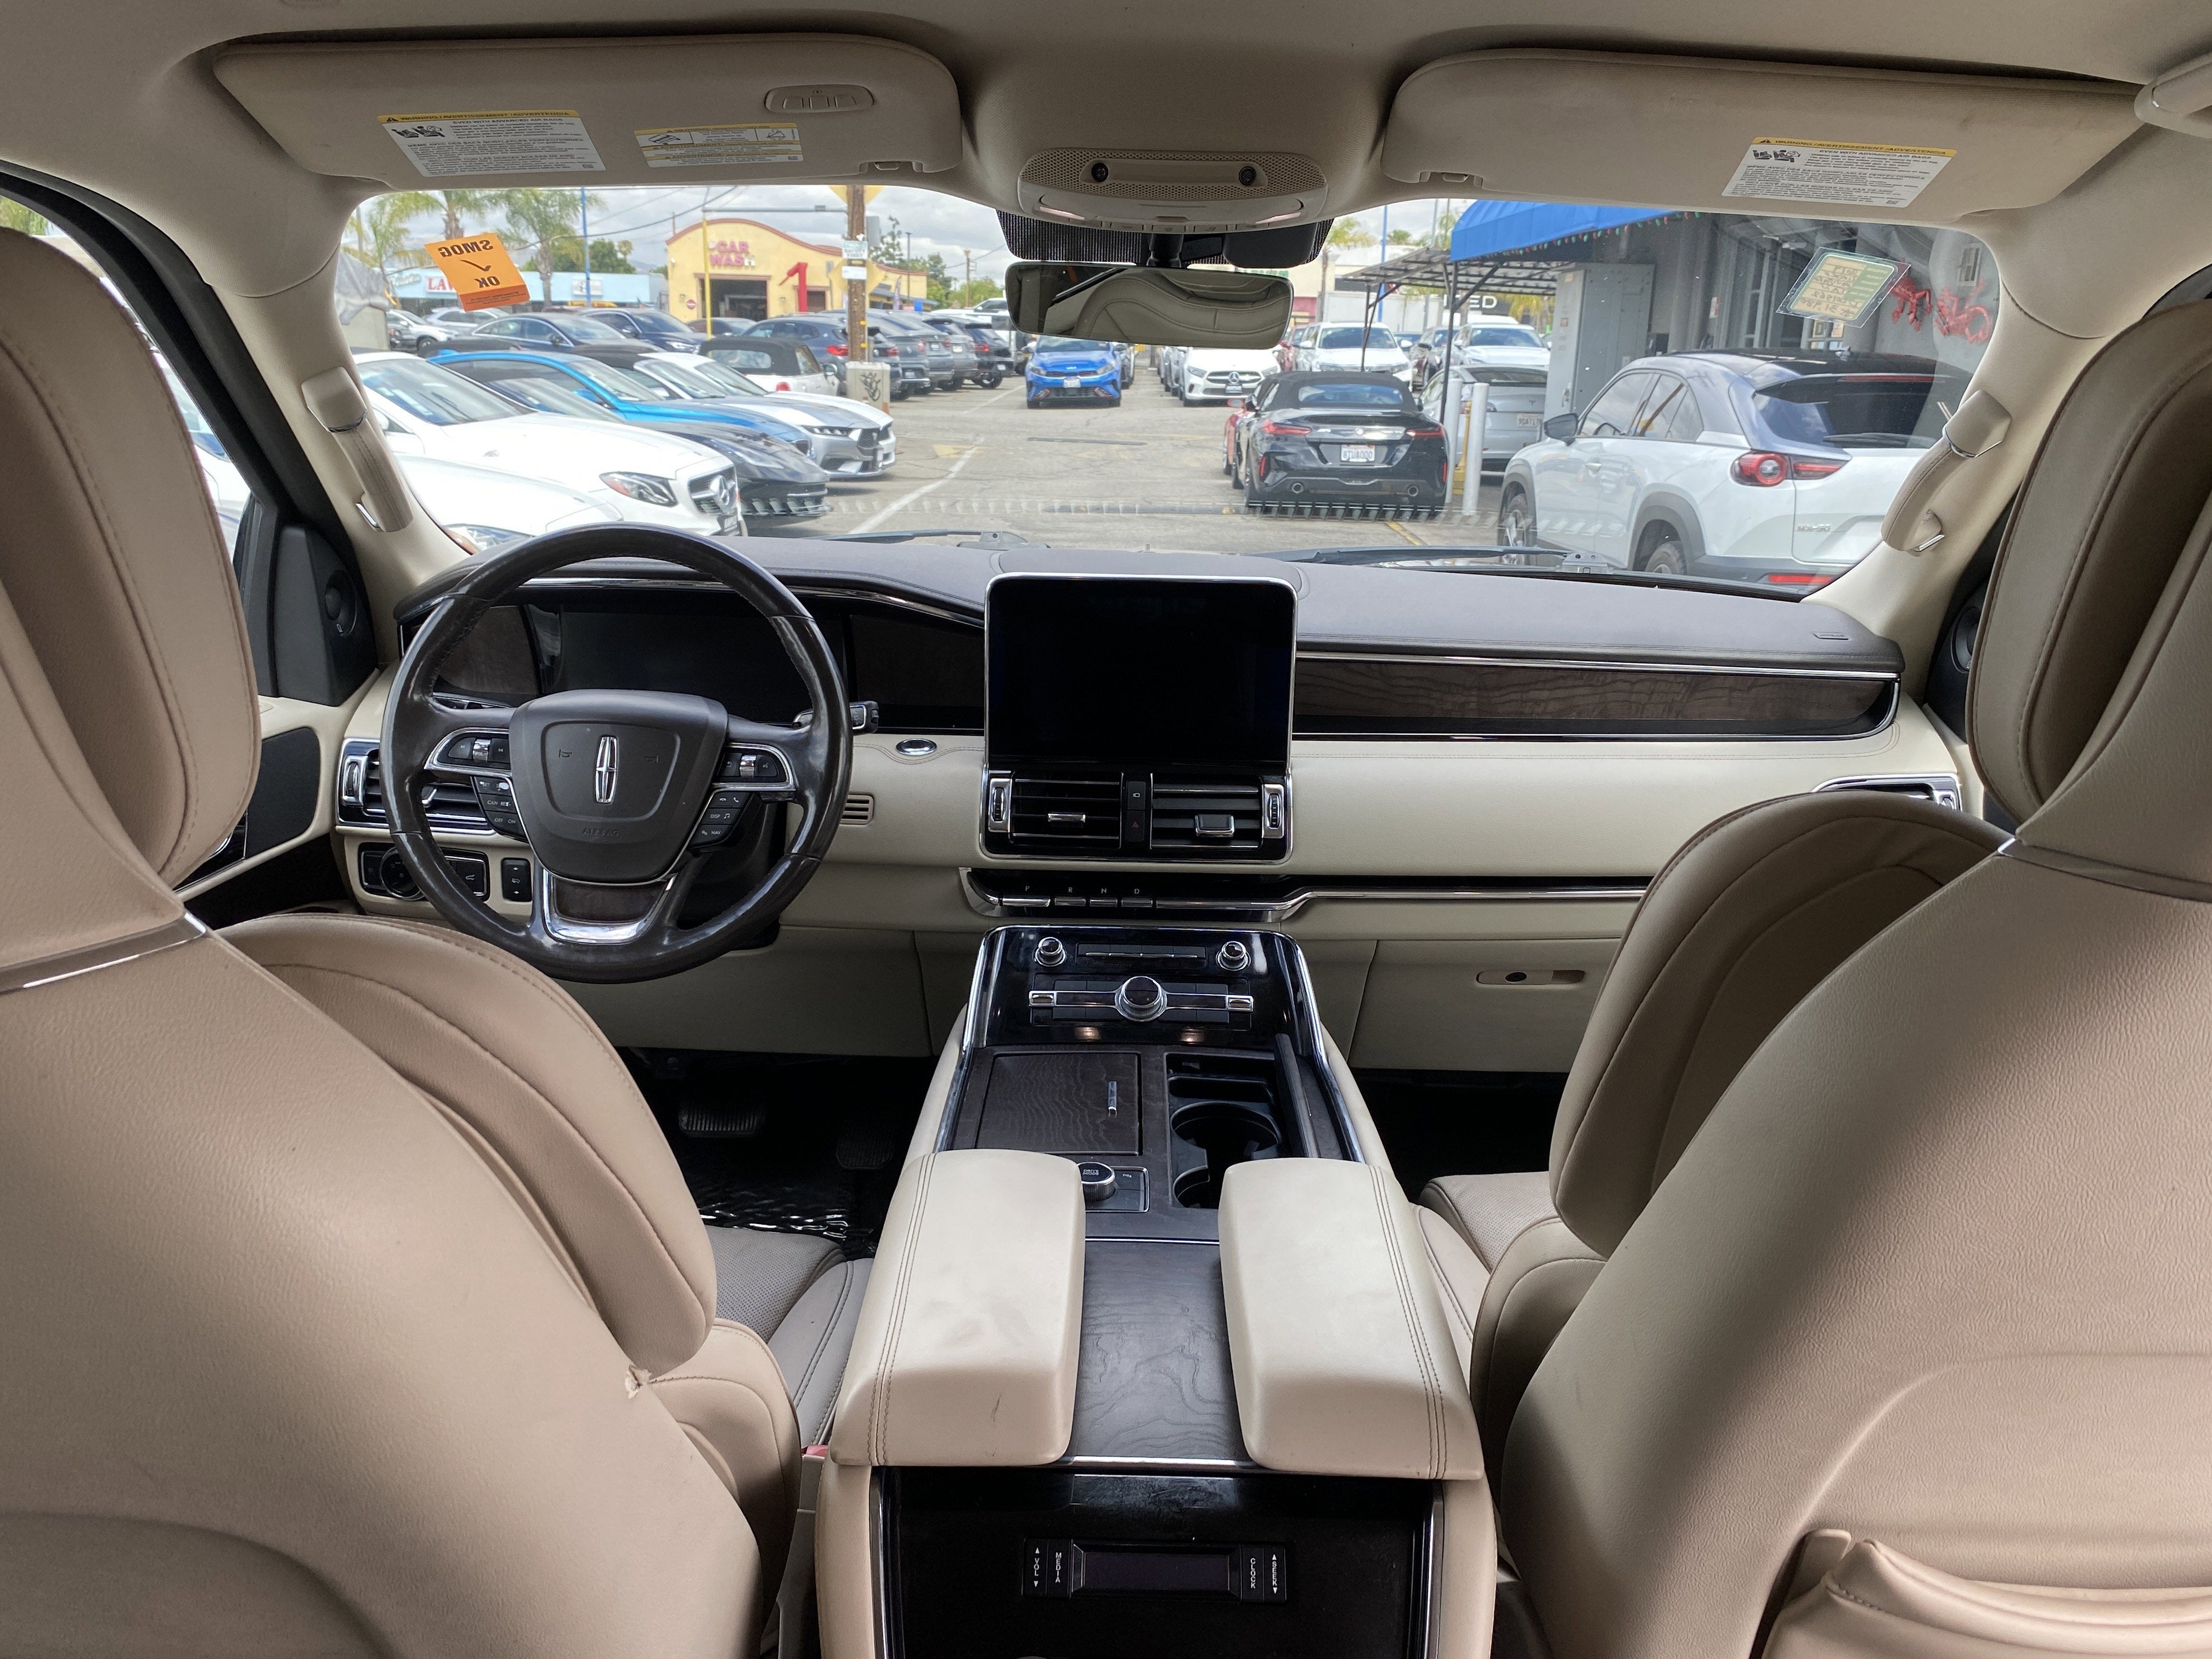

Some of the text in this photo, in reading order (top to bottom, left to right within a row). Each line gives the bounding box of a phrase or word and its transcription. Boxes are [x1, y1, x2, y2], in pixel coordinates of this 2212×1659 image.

[716, 240, 749, 253] CAR
[709, 254, 755, 268] WASH
[582, 827, 619, 837] AIRBAG
